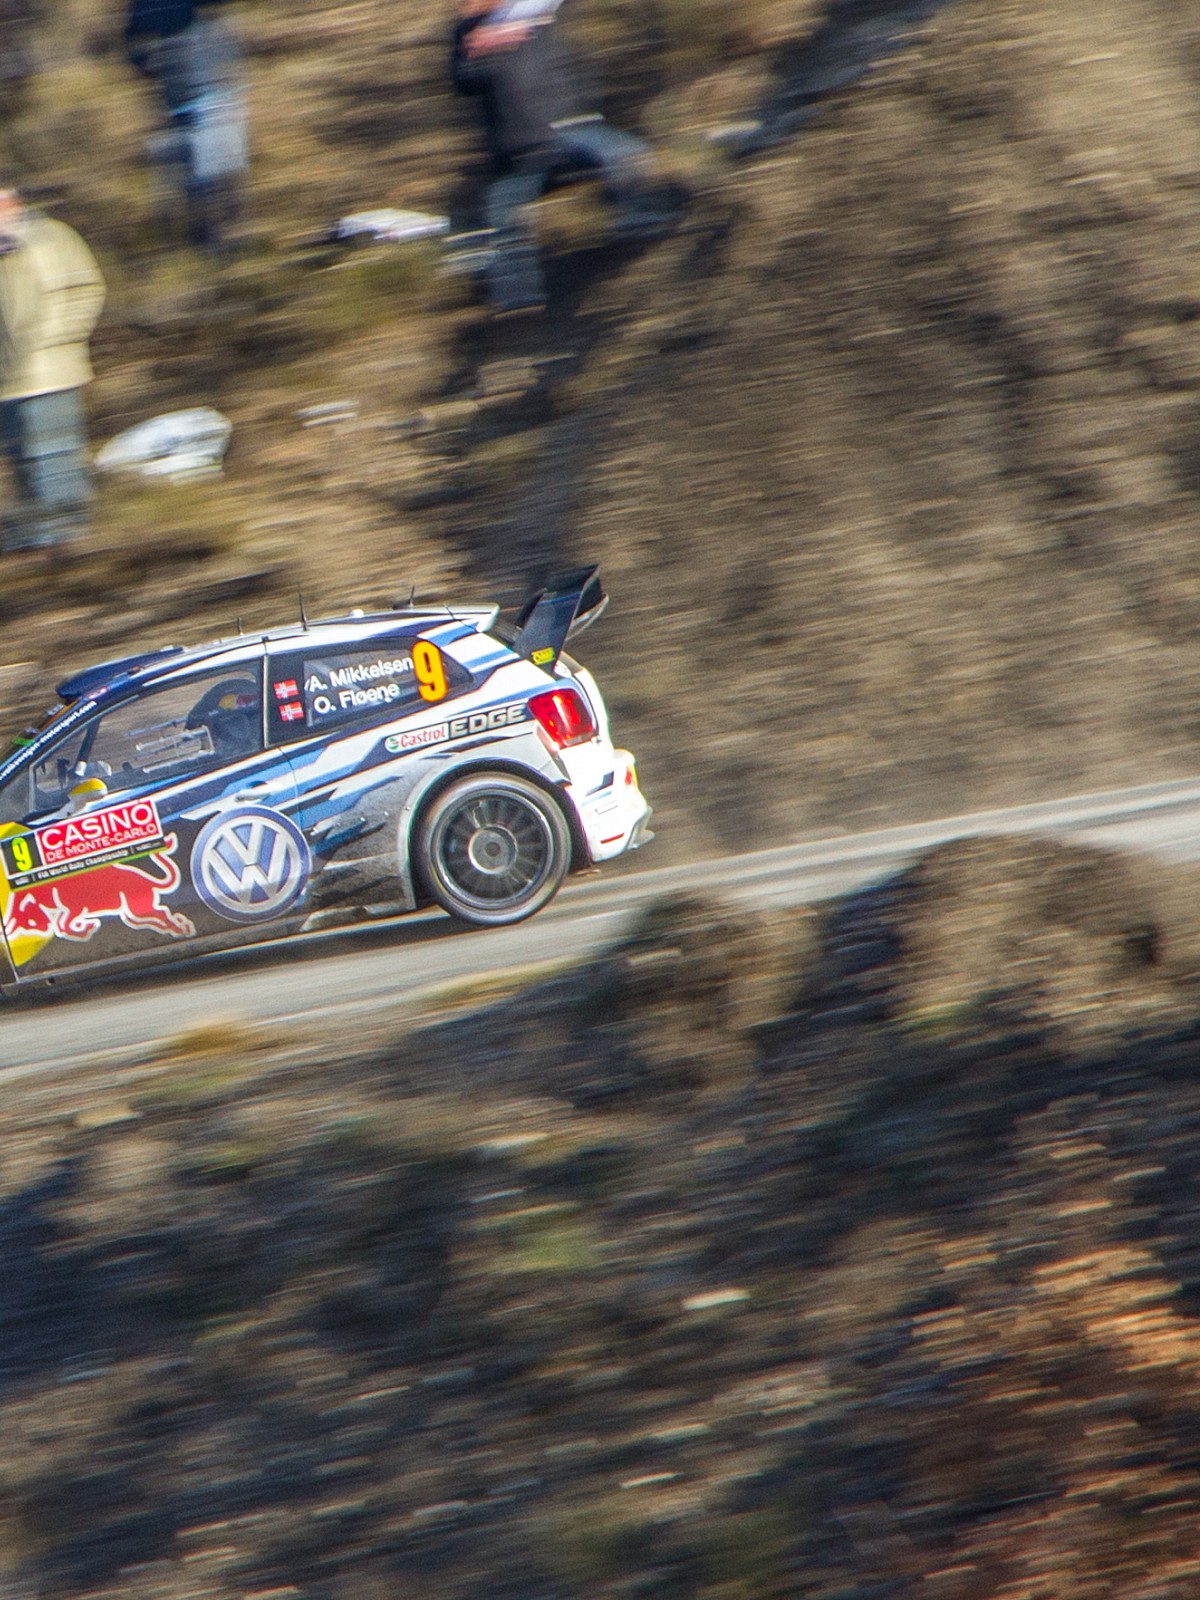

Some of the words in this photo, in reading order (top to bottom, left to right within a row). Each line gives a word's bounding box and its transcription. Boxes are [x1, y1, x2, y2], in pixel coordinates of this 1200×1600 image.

[309, 675, 328, 693] A.
[330, 656, 414, 688] Mikkelsen
[412, 640, 448, 703] 9
[313, 696, 337, 714] O.
[339, 682, 400, 709] Fløene
[400, 725, 446, 748] Castrol
[450, 703, 527, 738] EDGE
[41, 803, 152, 850] CASINO
[45, 848, 65, 862] DE
[66, 823, 157, 856] MONTE-CARLO
[11, 837, 33, 872] 9
[200, 813, 301, 915] VW
